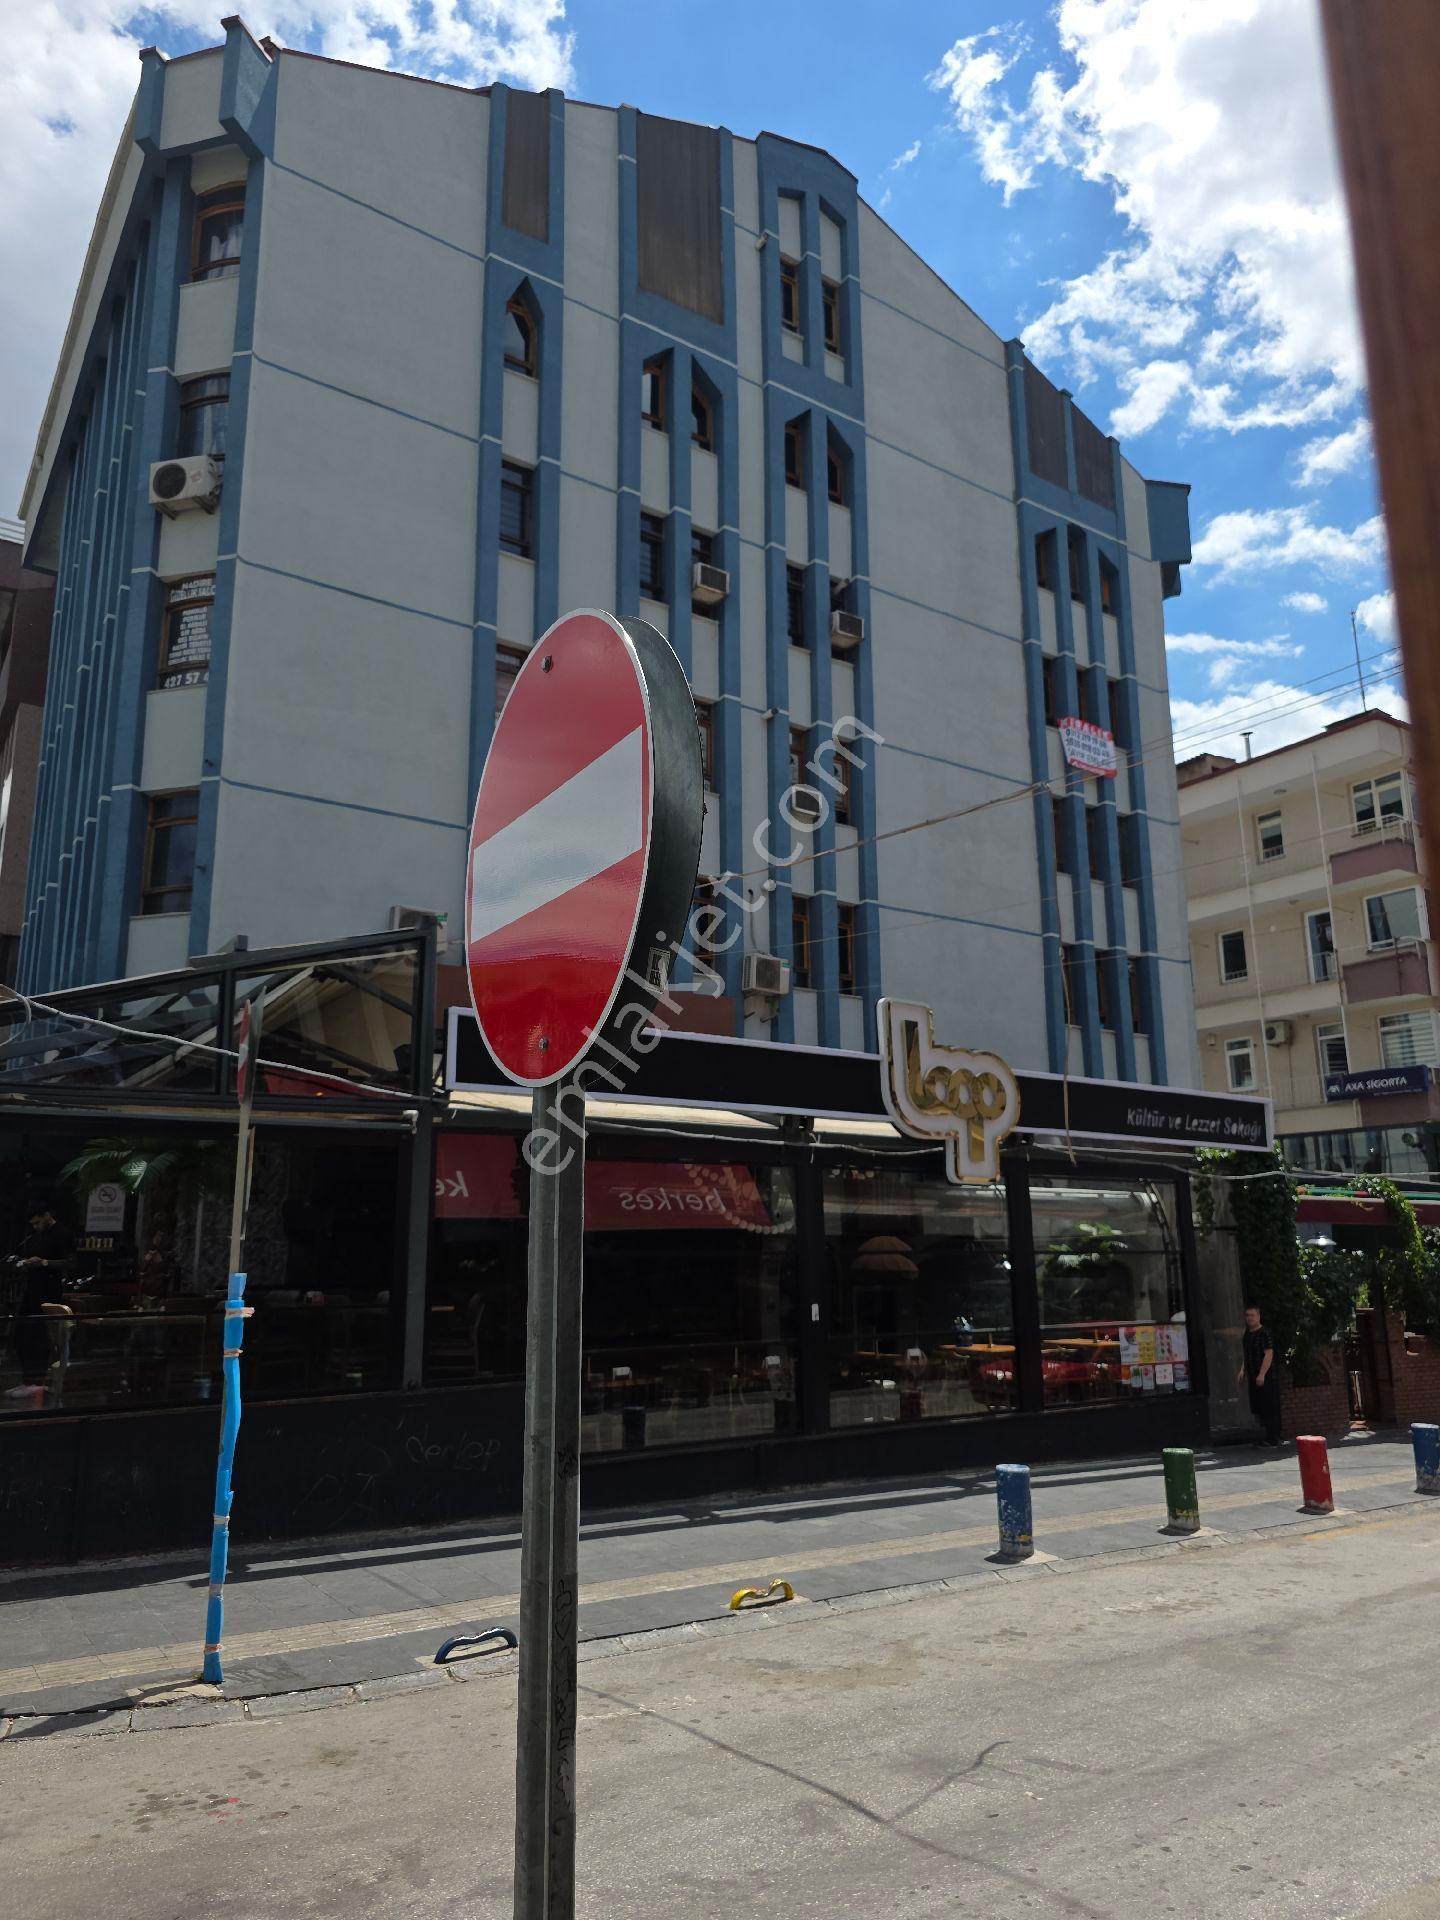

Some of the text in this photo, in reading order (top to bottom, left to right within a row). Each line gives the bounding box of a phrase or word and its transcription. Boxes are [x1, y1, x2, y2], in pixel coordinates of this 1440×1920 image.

[185, 672, 200, 685] 57
[1345, 1080, 1364, 1092] AXA
[1127, 1108, 1262, 1142] Kültür ve Lezzet Sokağı
